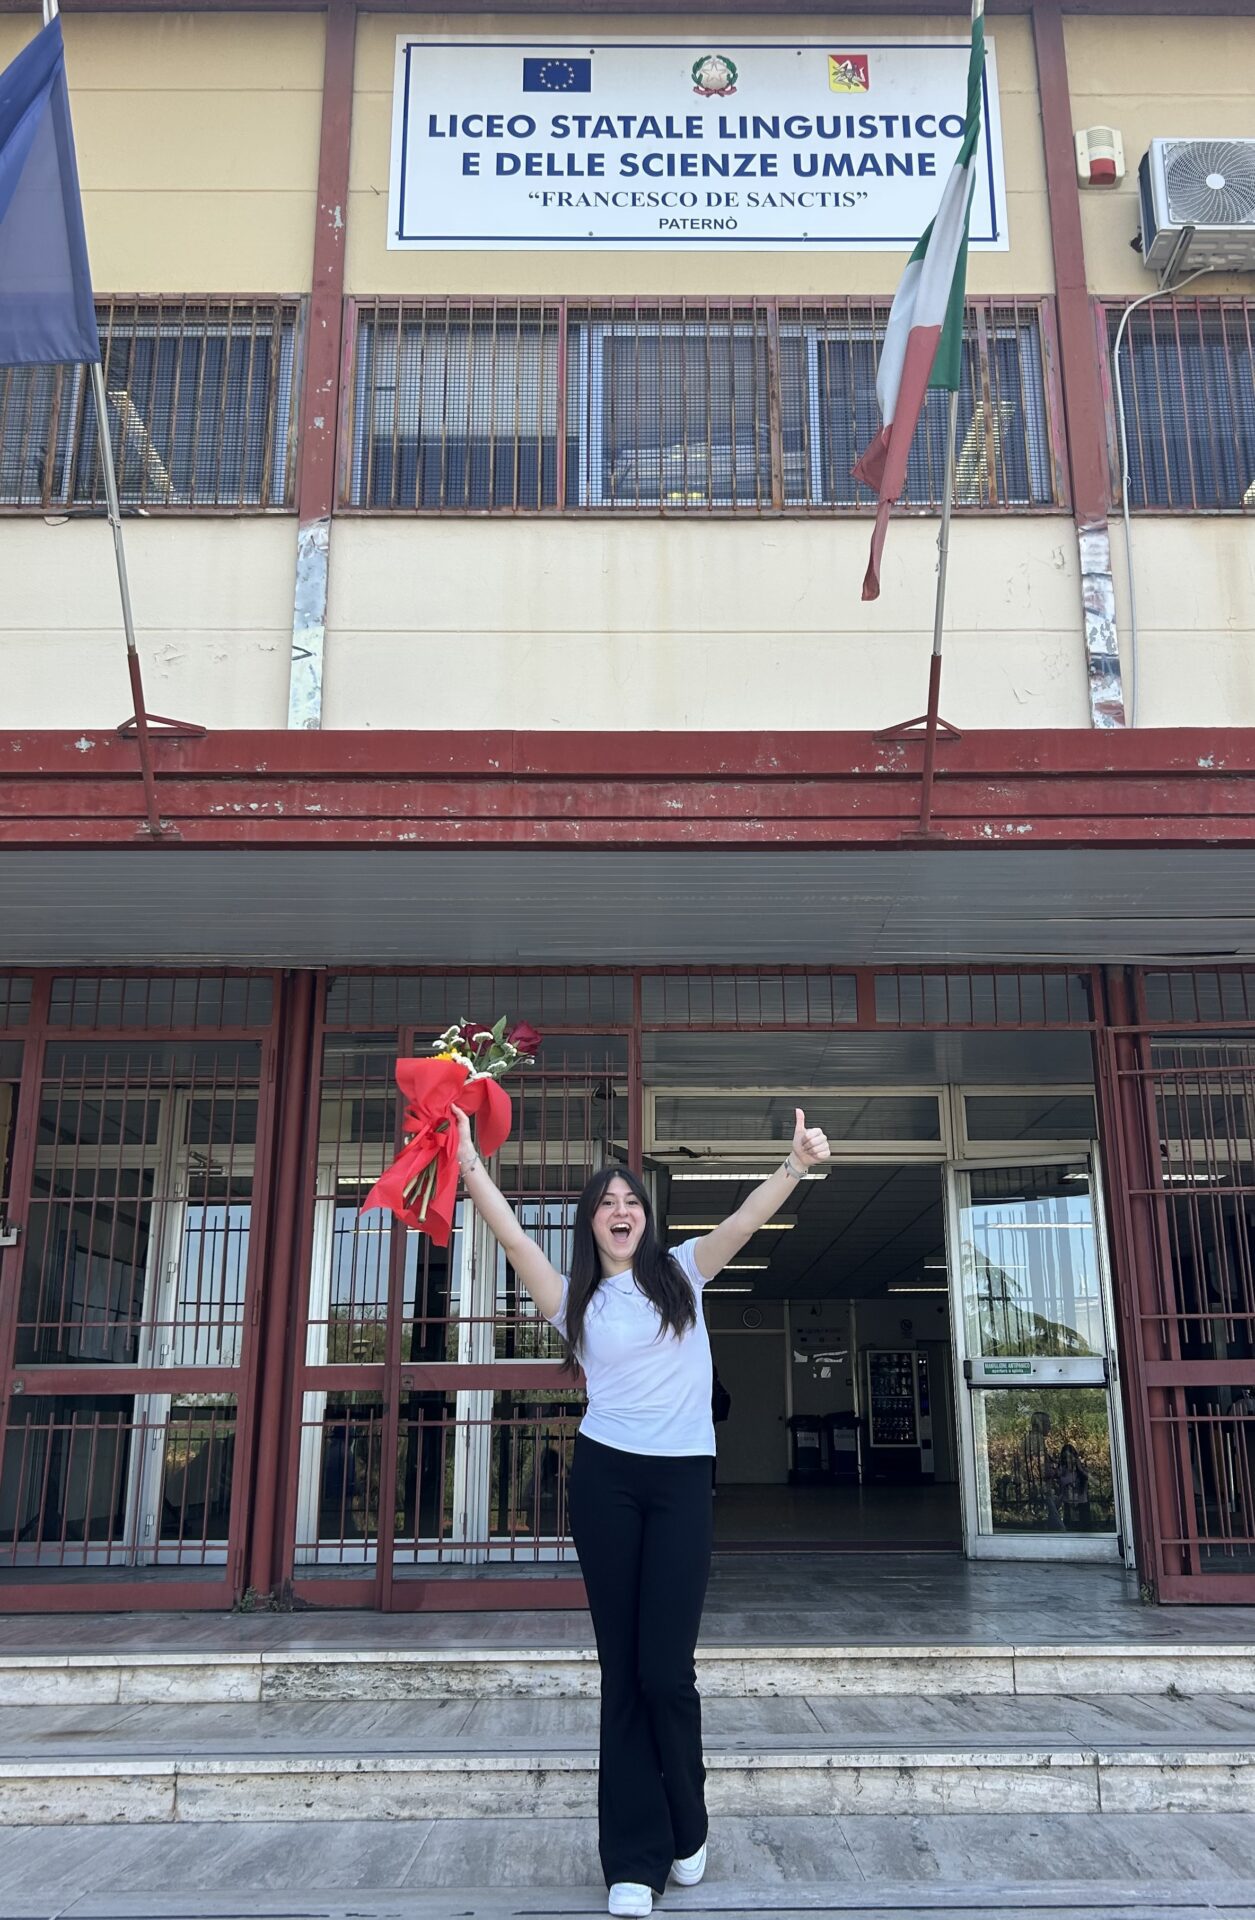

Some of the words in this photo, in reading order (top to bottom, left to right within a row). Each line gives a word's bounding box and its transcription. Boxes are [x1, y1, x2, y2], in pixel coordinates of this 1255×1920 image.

[428, 114, 537, 139] LICEO
[550, 114, 704, 139] STATALE
[718, 114, 966, 139] LINGUISTICO
[462, 152, 480, 176] E
[495, 152, 605, 177] DELLE
[619, 152, 778, 178] SCIENZE
[793, 152, 936, 177] UMANE
[528, 191, 698, 208] “FRANCESCO
[706, 191, 740, 208] DE
[746, 191, 868, 208] SANCTIS”
[659, 216, 738, 230] PATERNÒ
